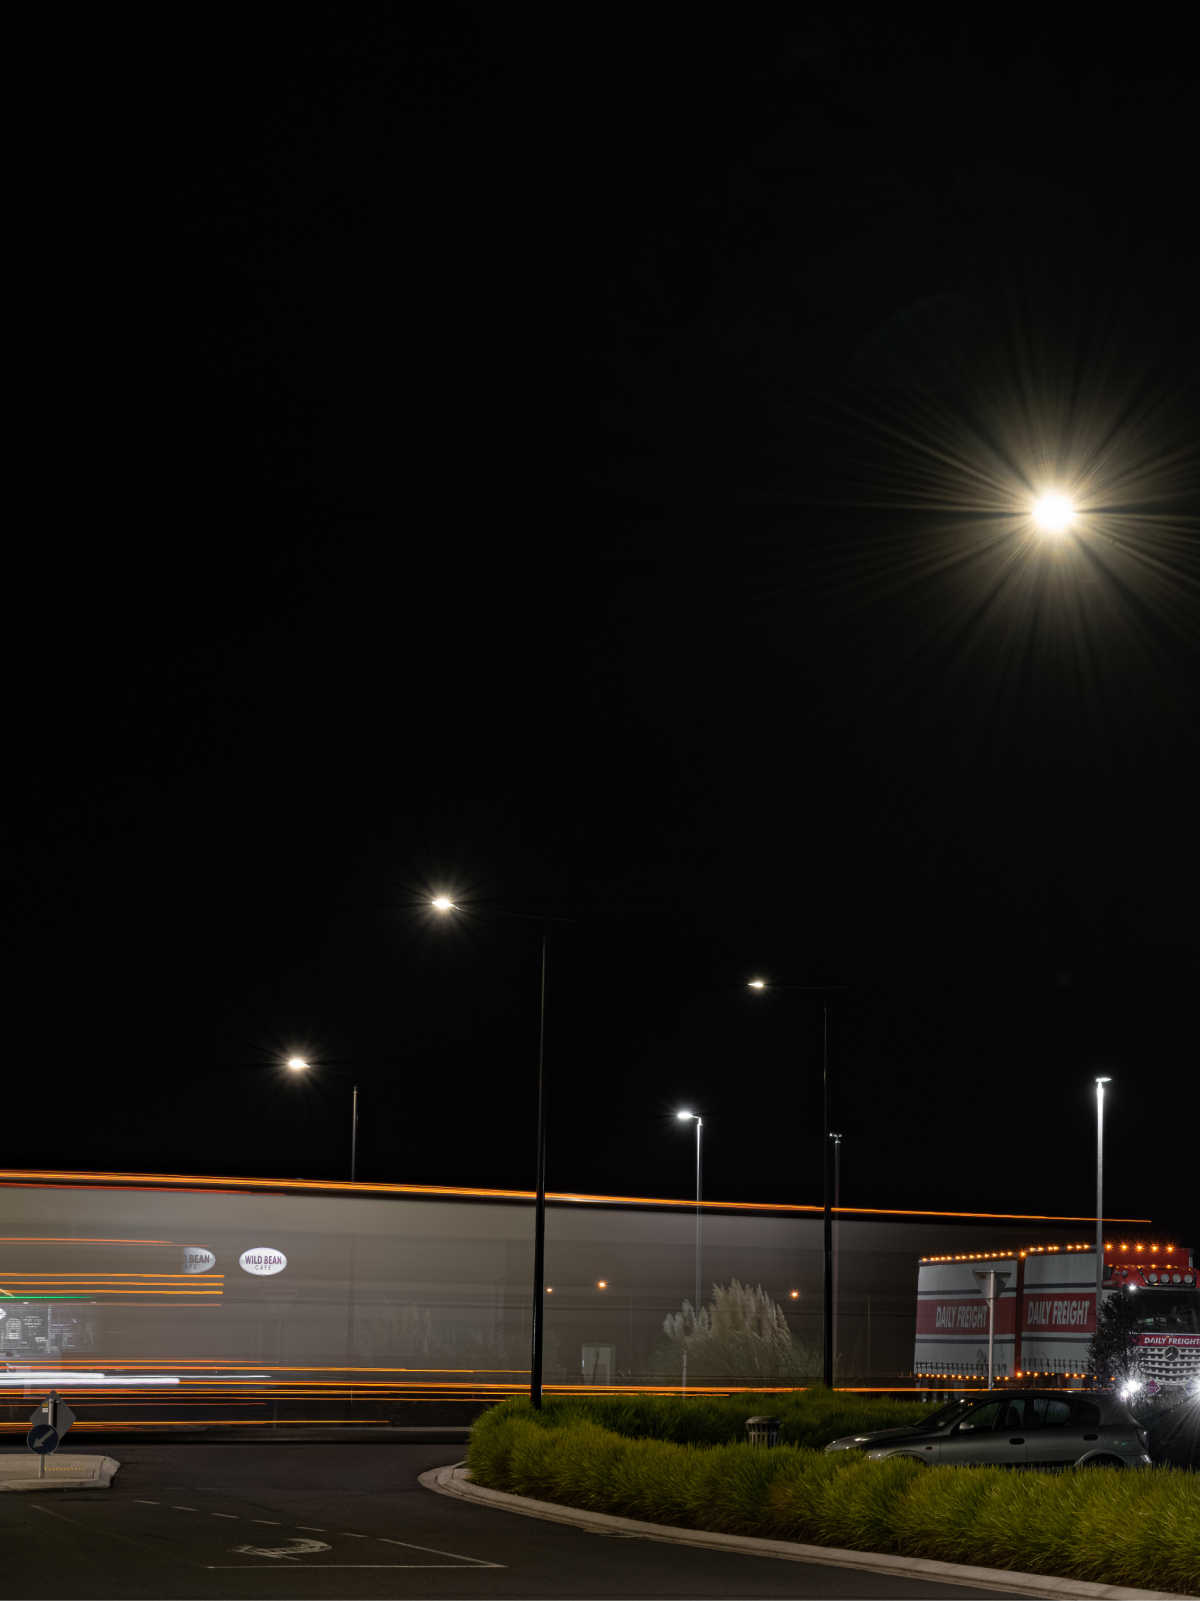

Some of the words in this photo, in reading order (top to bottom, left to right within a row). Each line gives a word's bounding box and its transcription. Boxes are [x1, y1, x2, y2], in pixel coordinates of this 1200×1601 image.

[189, 1254, 210, 1264] BEAN
[245, 1255, 262, 1265] WILD
[264, 1255, 282, 1265] BEAN
[935, 1305, 956, 1328] DAILY
[957, 1305, 989, 1328] FREIGHT
[1027, 1301, 1052, 1325] DAILY
[1052, 1300, 1090, 1325] FREIGHT
[1168, 1337, 1200, 1345] FREIGHT
